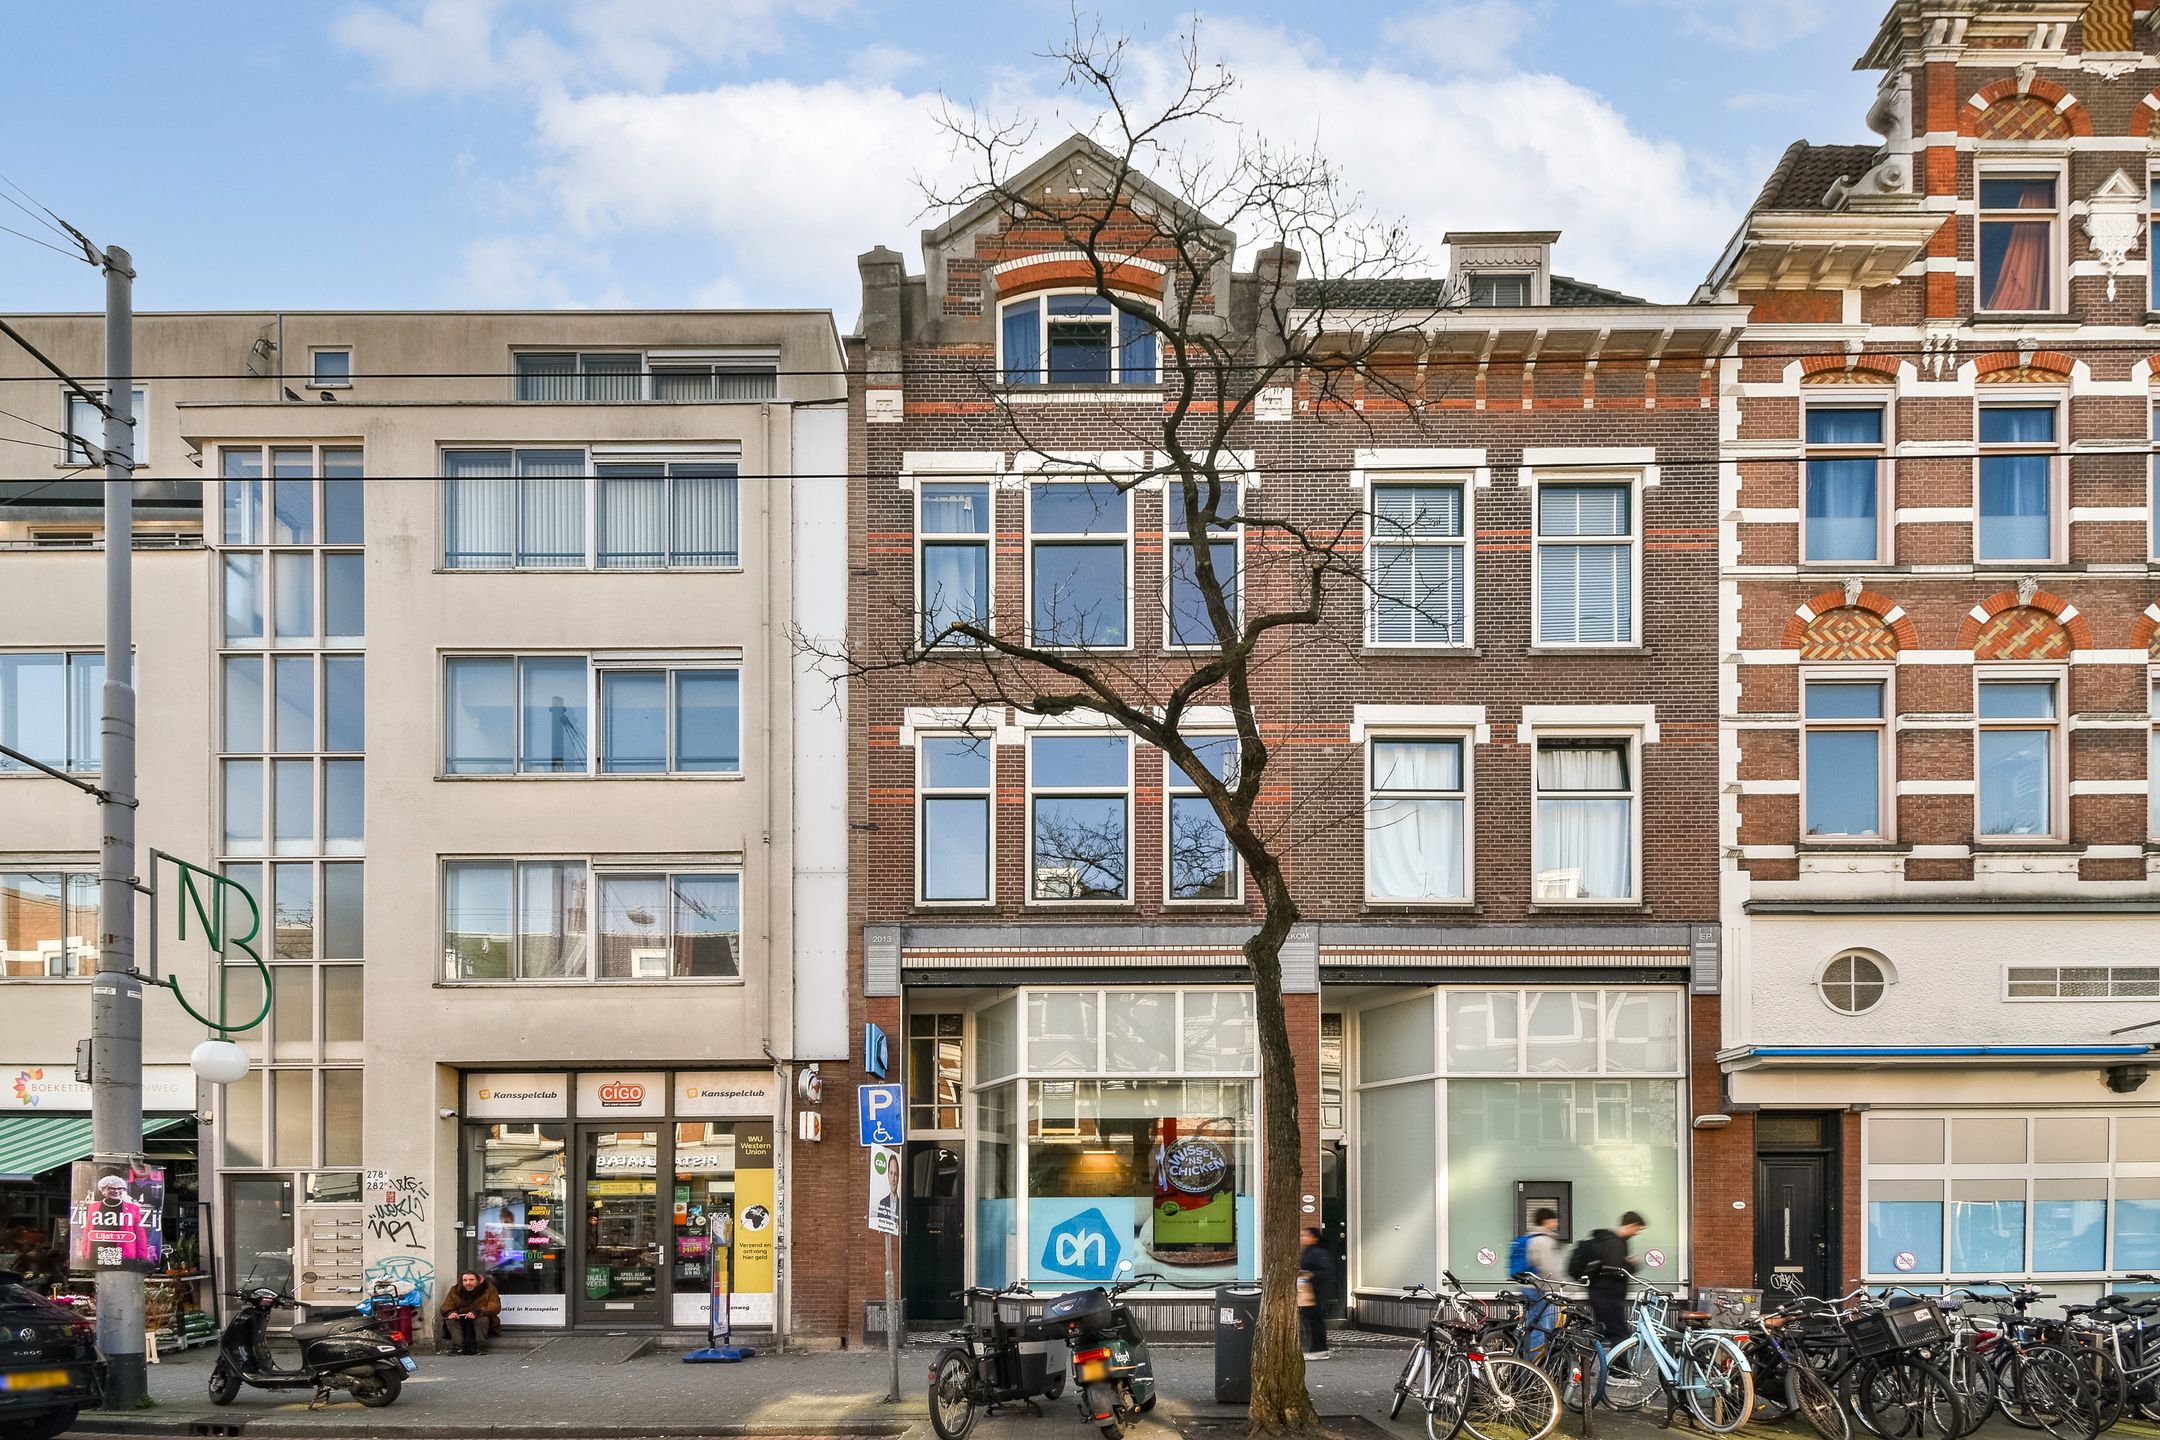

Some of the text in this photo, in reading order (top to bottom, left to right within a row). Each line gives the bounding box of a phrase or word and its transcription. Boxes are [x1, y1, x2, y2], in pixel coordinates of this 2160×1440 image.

[872, 935, 892, 943] 2013
[493, 1091, 558, 1101] Kansspelclub
[601, 1086, 642, 1100] CIGO
[701, 1089, 765, 1099] Kansspelclub
[868, 1090, 893, 1121] P
[741, 1142, 772, 1150] Western
[1168, 1144, 1218, 1166] WISSEL
[875, 1159, 887, 1169] CDA
[1185, 1156, 1203, 1165] 'NS
[1169, 1157, 1225, 1177] CHICKEN
[70, 1206, 162, 1232] Zij aan Zij
[95, 1232, 114, 1241] Lijst
